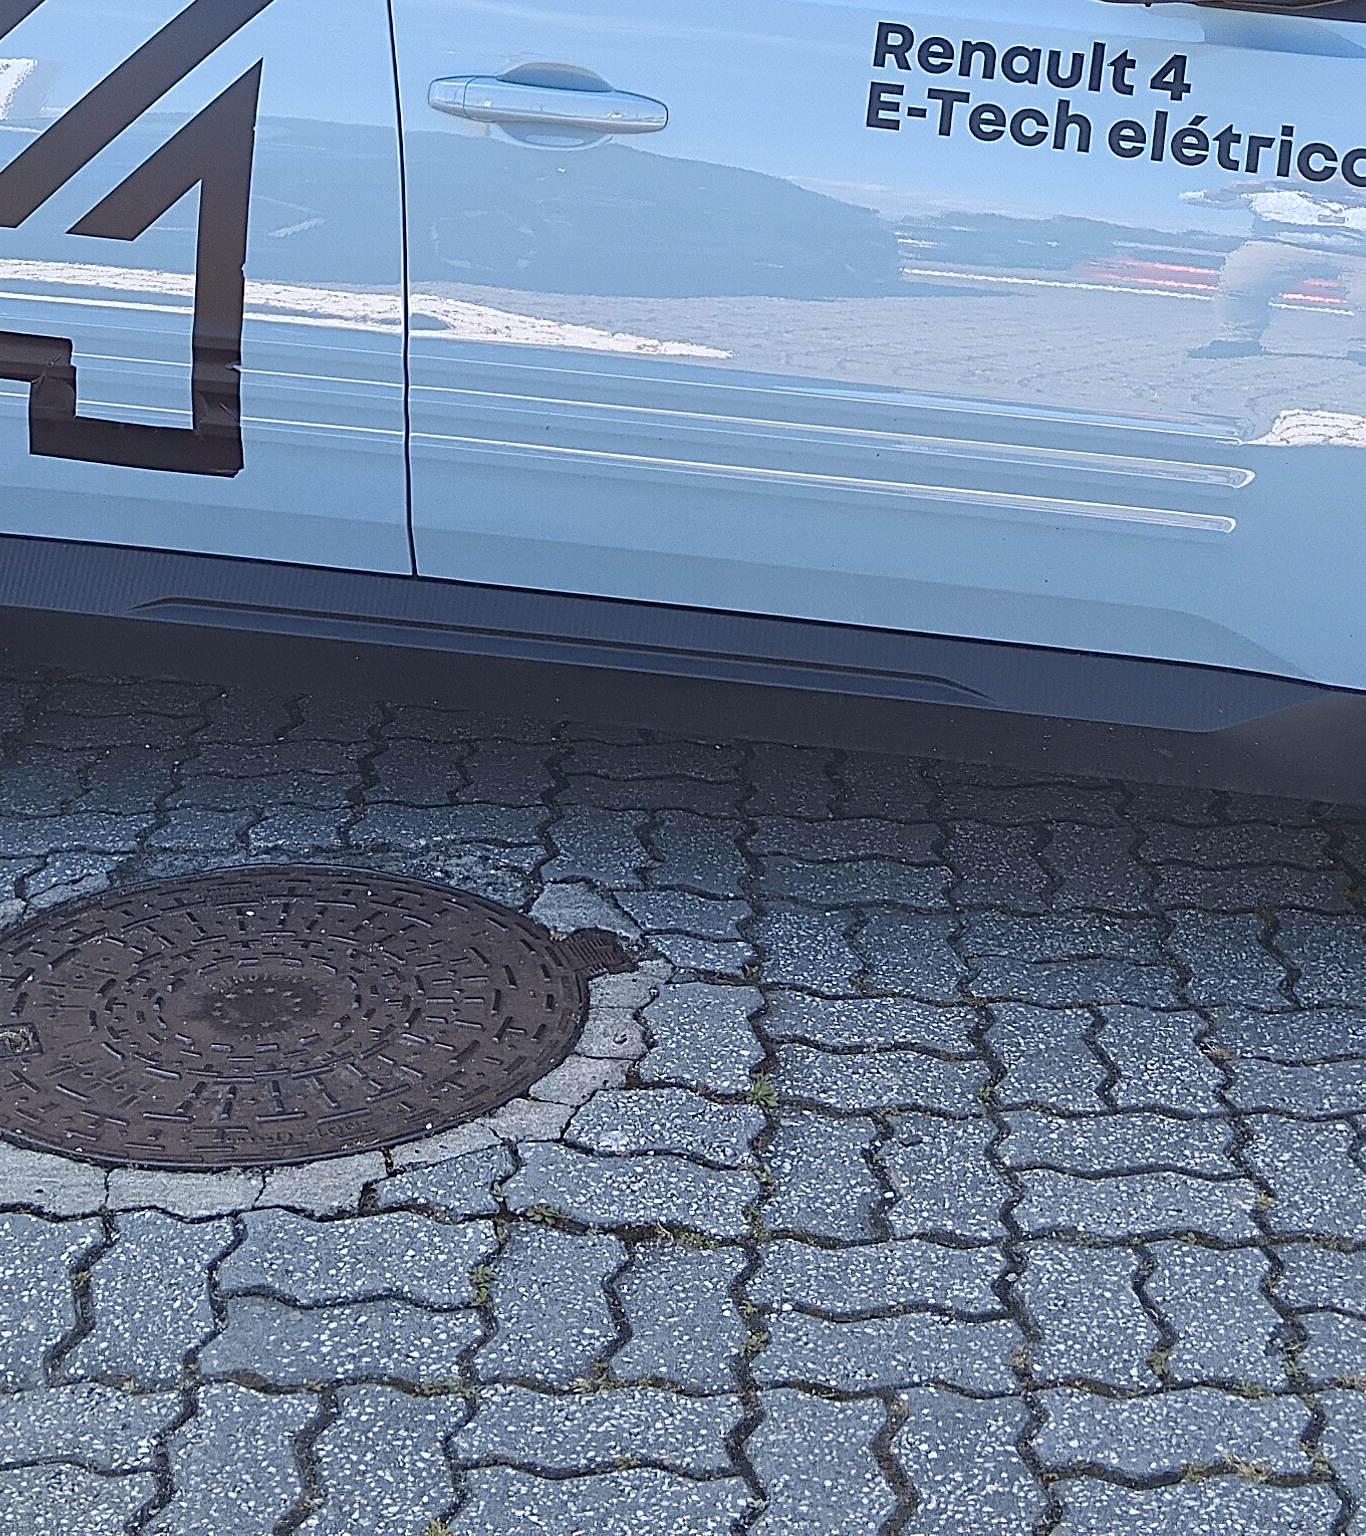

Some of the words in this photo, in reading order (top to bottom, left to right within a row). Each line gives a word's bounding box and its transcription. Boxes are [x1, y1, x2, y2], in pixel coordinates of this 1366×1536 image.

[873, 21, 1137, 96] Renault
[1149, 54, 1192, 102] 4
[865, 80, 1093, 154] E-Tech
